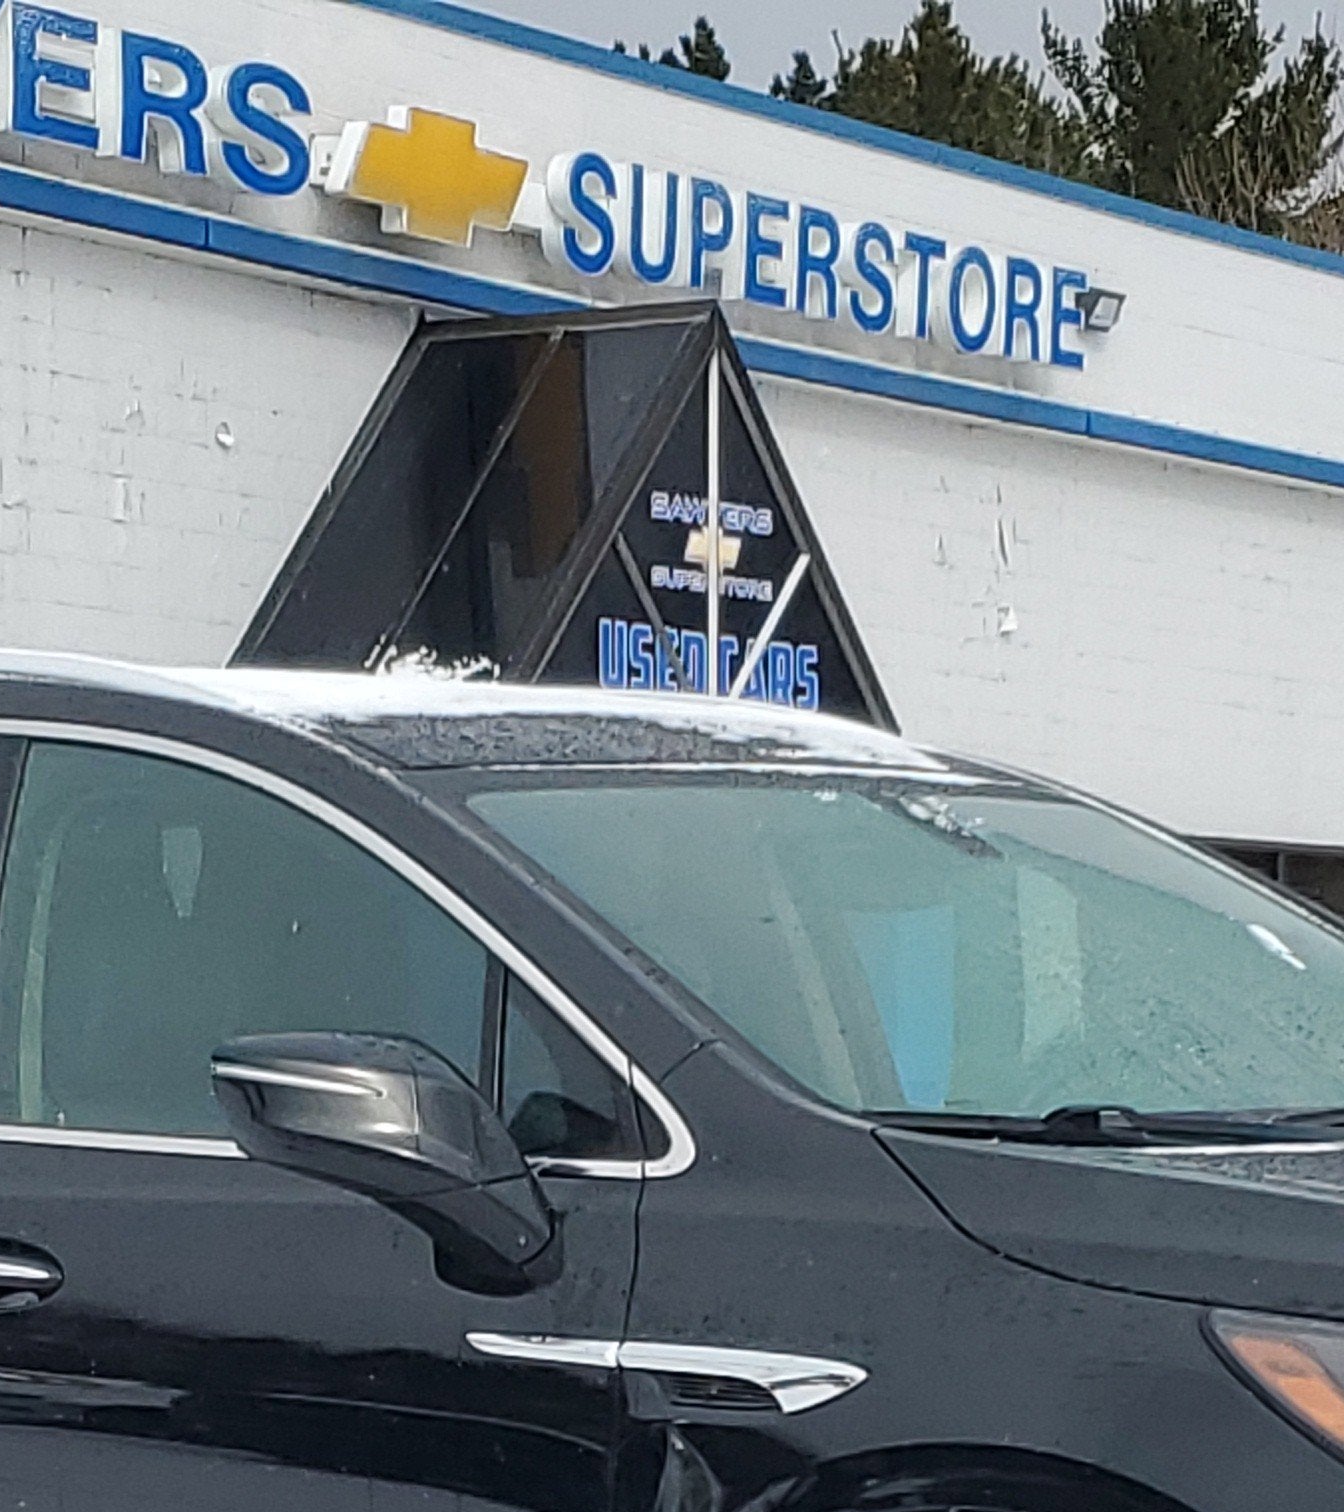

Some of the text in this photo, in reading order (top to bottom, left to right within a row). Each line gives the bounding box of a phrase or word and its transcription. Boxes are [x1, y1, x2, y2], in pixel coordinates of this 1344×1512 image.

[559, 151, 1087, 372] SUPERSTORE
[651, 491, 773, 535] SAWERS
[599, 617, 707, 690] USED
